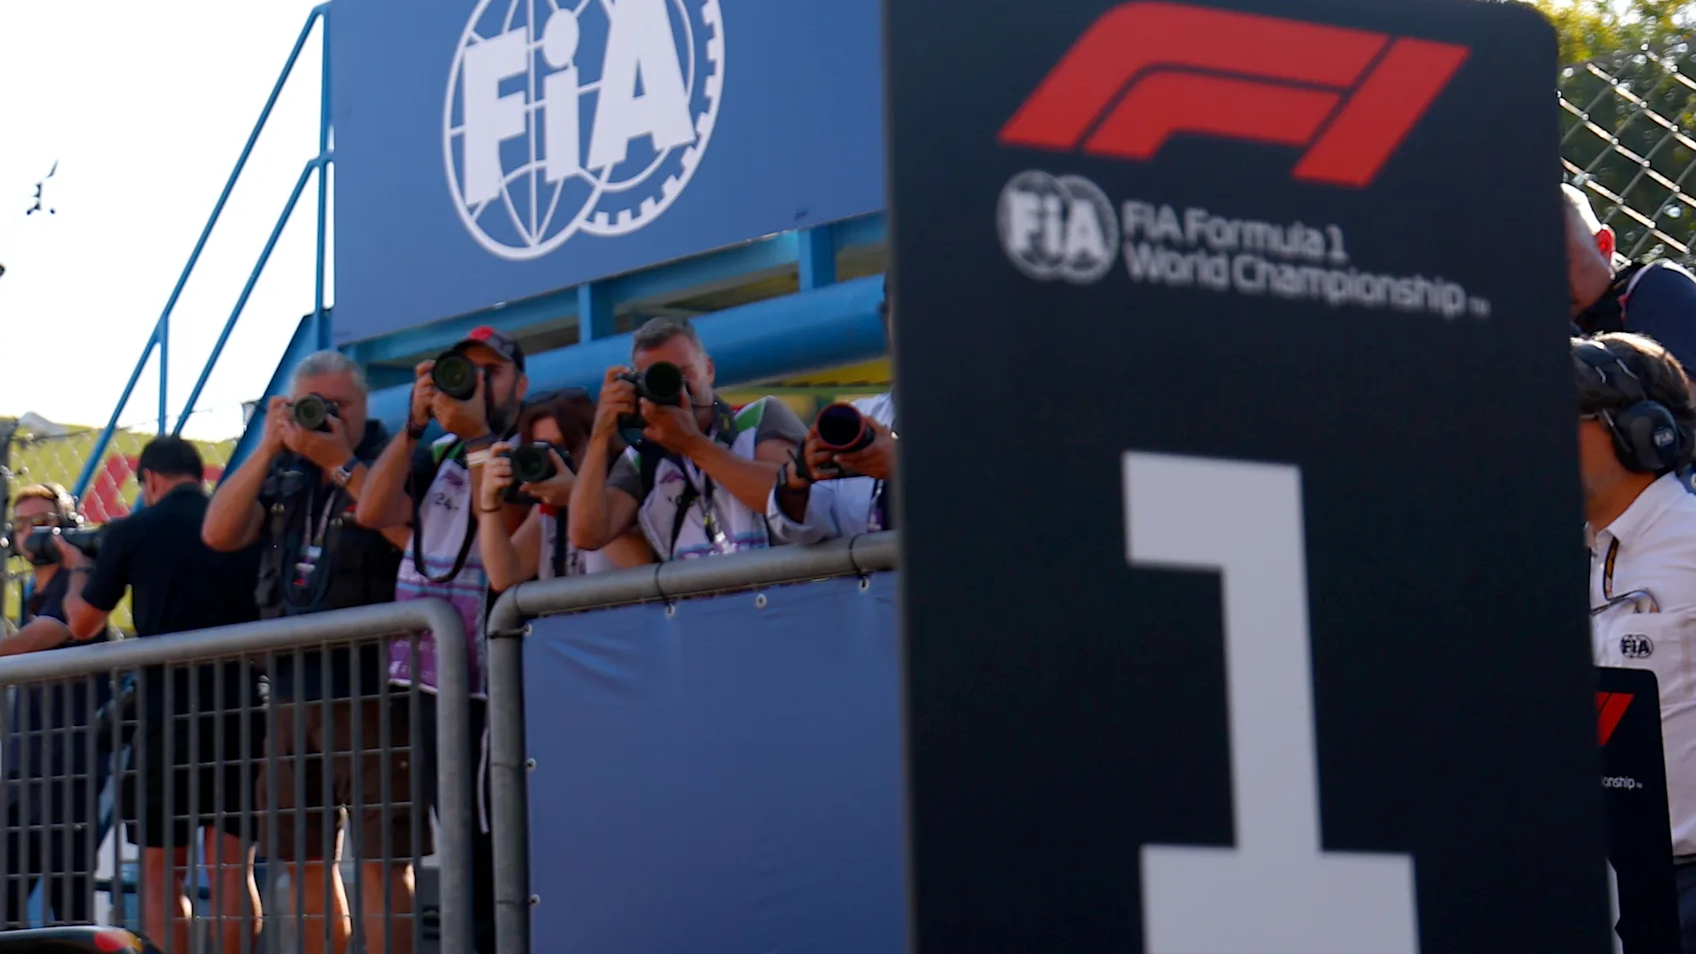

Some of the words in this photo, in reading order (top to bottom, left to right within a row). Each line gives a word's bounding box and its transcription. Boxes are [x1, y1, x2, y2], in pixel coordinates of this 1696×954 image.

[996, 0, 1471, 187] F1
[1122, 199, 1183, 241] FIA
[1184, 206, 1329, 260] Formula
[1329, 224, 1348, 262] 1
[1123, 242, 1230, 289] World
[1122, 449, 1419, 954] 1
